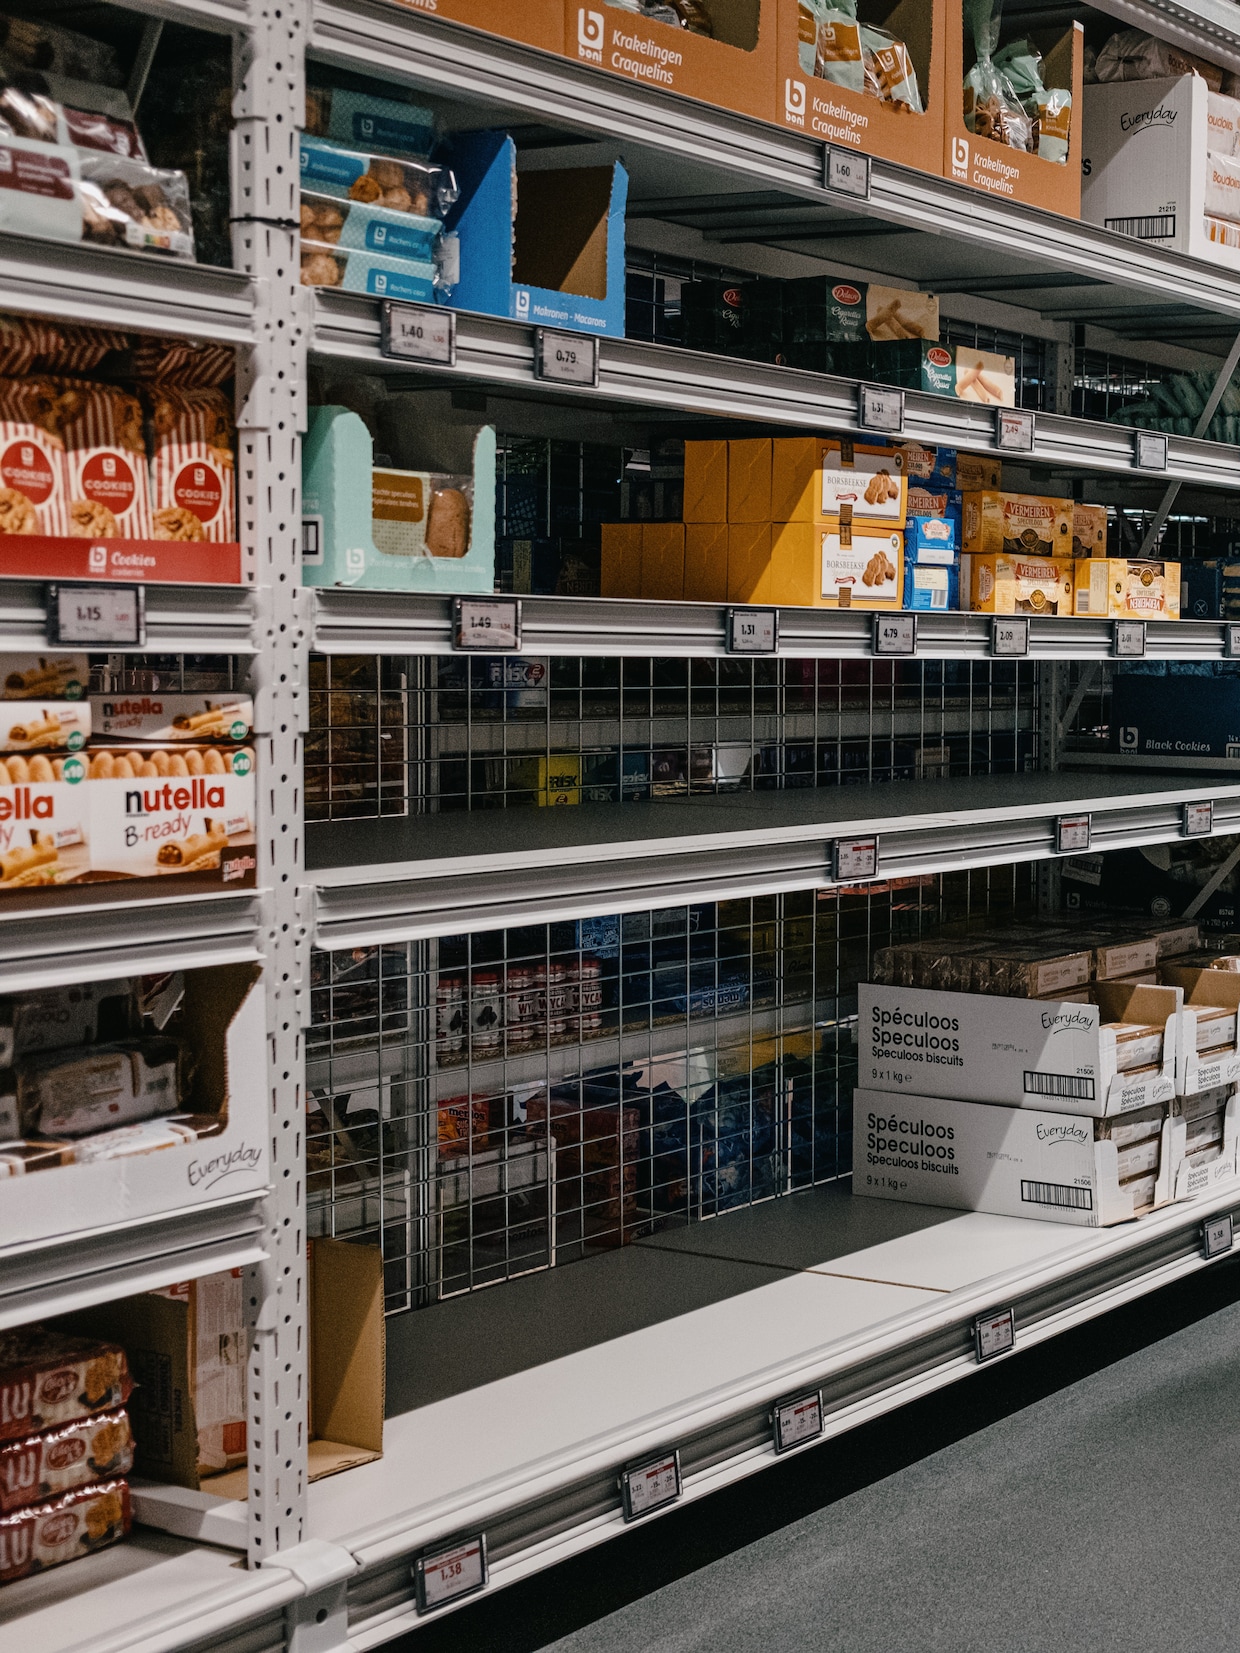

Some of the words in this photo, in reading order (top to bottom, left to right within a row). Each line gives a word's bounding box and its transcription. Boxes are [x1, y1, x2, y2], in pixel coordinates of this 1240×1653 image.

[578, 43, 602, 63] boni
[612, 29, 683, 66] Krakelingen
[611, 51, 674, 84] Craquelins
[785, 110, 804, 127] boni
[812, 97, 869, 128] Krakelingen
[1120, 105, 1178, 131] Everyday
[811, 117, 861, 145] Craquelins
[952, 165, 968, 180] boni
[973, 152, 1020, 180] Krakelingen
[973, 170, 1014, 195] Craquelins
[1212, 171, 1240, 189] Boudoirs
[533, 304, 569, 320] Makronen
[573, 312, 607, 328] Macarons
[84, 479, 134, 492] COOKIES
[827, 475, 868, 488] BORSBEEKSE
[177, 489, 220, 501] COOKIES
[1009, 502, 1051, 517] VERMEIREN
[111, 551, 157, 568] Cookies
[826, 560, 865, 571] BORSBEEKSE
[1019, 564, 1057, 578] VERMEIREN
[1129, 597, 1161, 611] VERMEIREN
[1145, 739, 1173, 750] Black
[1174, 740, 1211, 752] Cookies
[125, 779, 225, 817] nutella
[872, 1006, 960, 1032] Spéculoos
[1041, 1011, 1094, 1031] Everyday
[872, 1026, 960, 1052] Speculoos
[872, 1046, 924, 1063] Speculoos
[925, 1049, 964, 1067] biscuits
[872, 1068, 878, 1079] 9
[893, 1070, 903, 1083] kg
[867, 1112, 955, 1140] Spéculoos
[1036, 1122, 1089, 1143] Everyday
[867, 1132, 956, 1160] Speculoos
[187, 1142, 262, 1187] Everyday
[867, 1153, 919, 1170] Speculoos
[921, 1156, 960, 1175] biscuits
[866, 1175, 873, 1186] 9
[888, 1177, 898, 1191] kg
[6, 1450, 38, 1493] LU
[440, 1562, 463, 1582] 1,38
